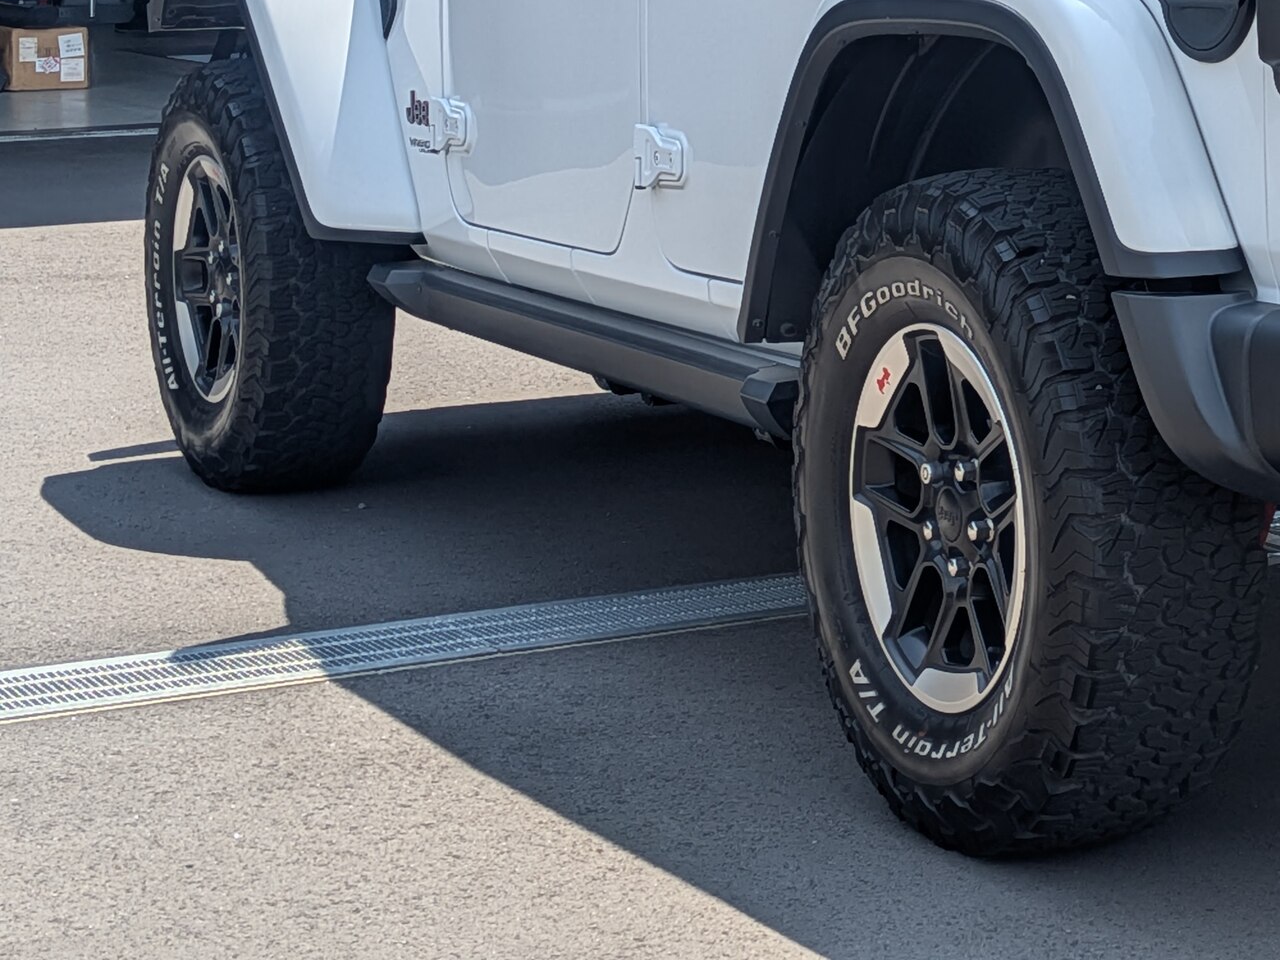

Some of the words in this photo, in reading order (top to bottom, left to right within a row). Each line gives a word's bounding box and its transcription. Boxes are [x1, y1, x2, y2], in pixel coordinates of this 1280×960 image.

[154, 162, 170, 205] T/A
[151, 219, 180, 390] All-Terrain
[835, 279, 974, 361] BFGoodrich
[849, 658, 887, 723] T/A
